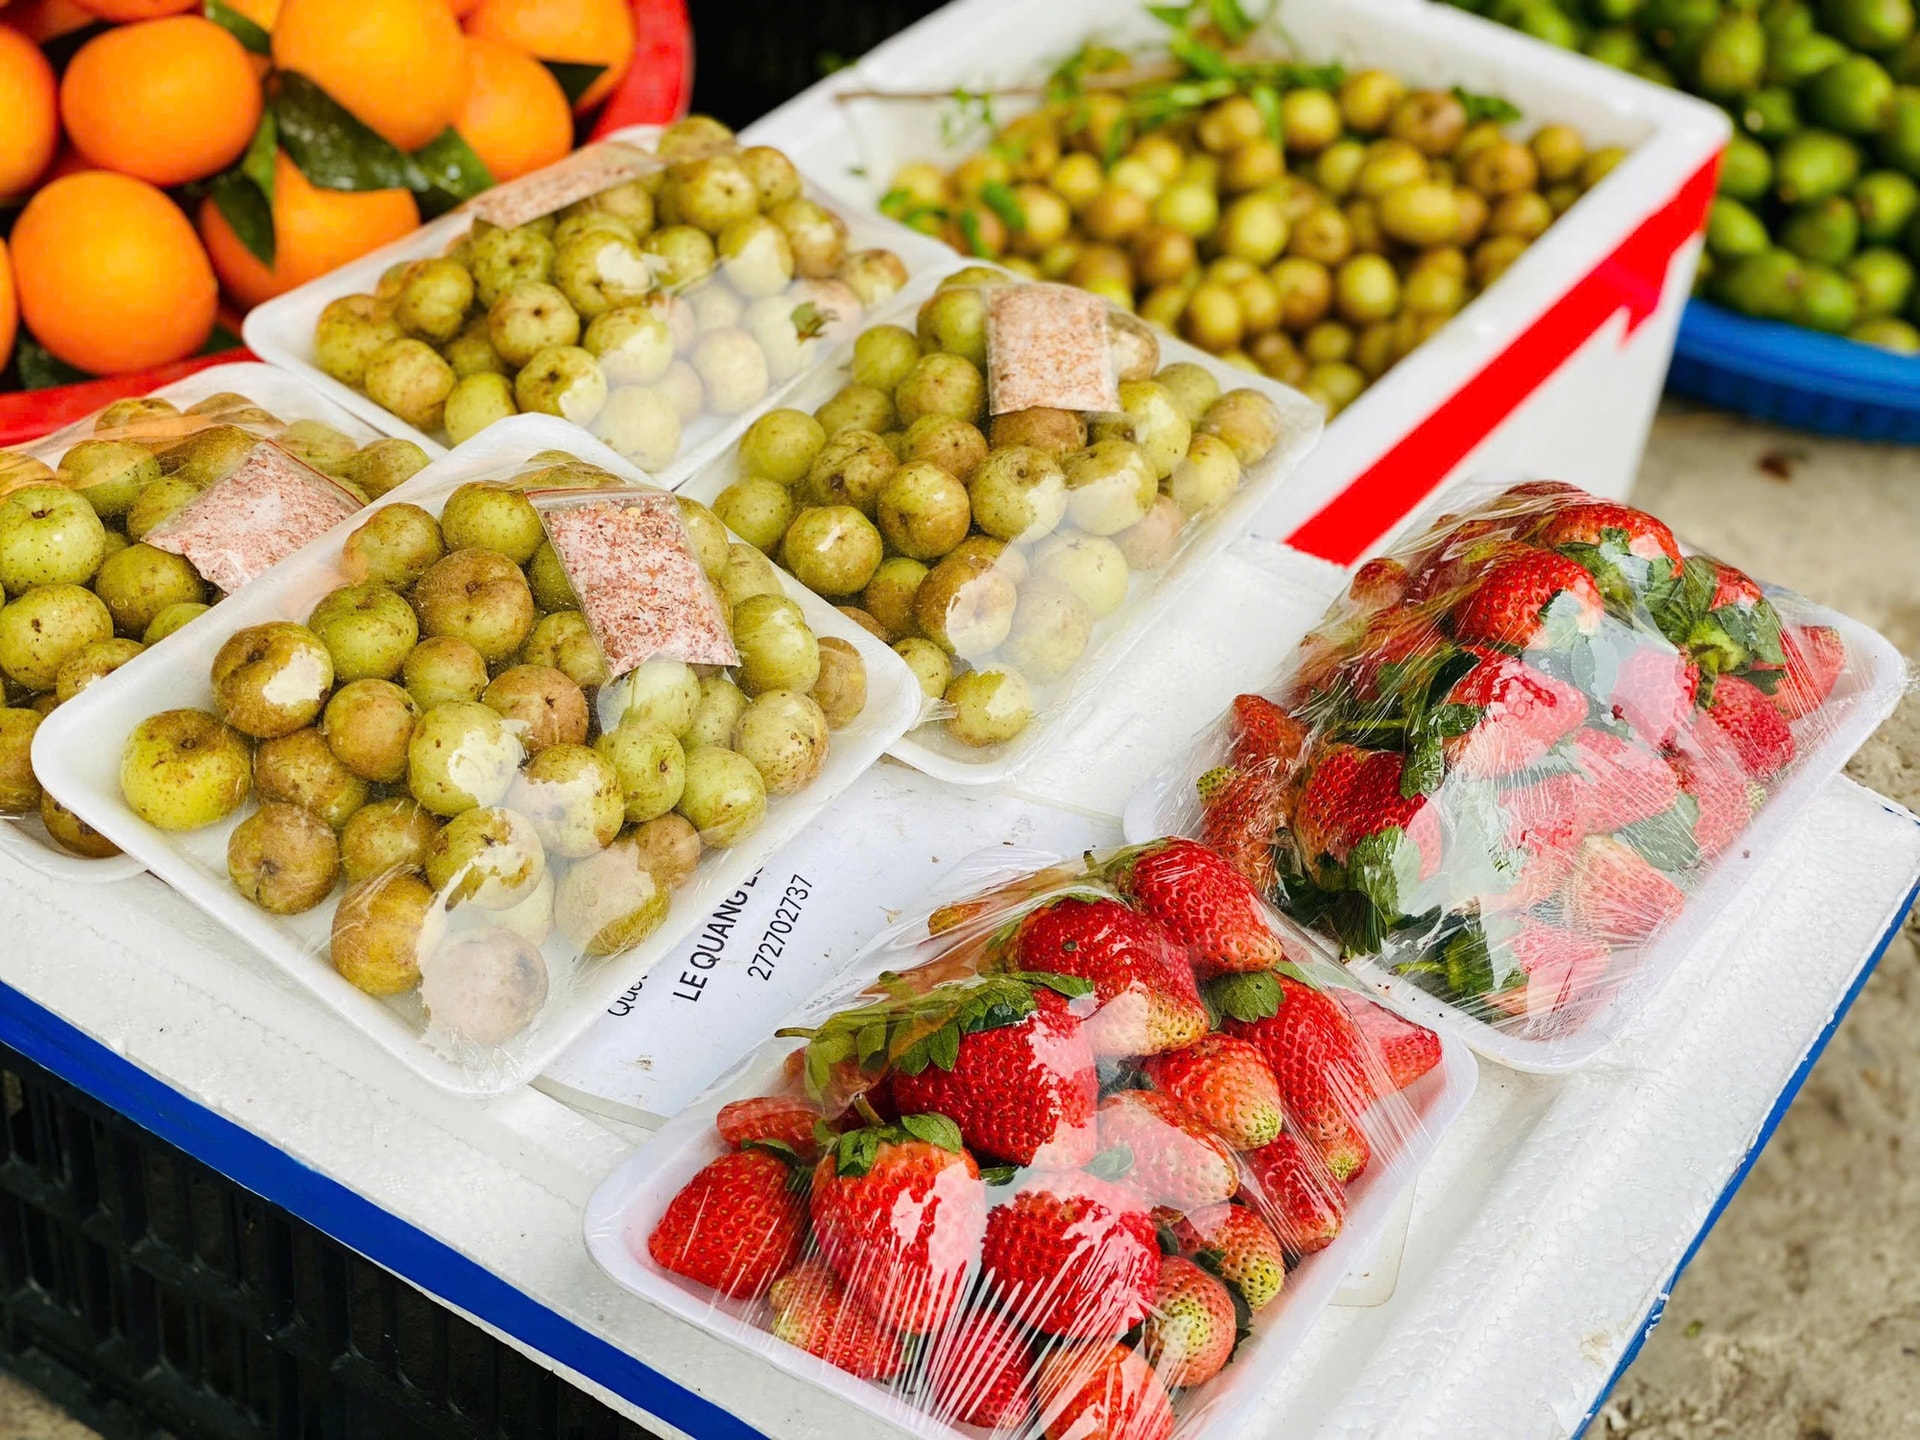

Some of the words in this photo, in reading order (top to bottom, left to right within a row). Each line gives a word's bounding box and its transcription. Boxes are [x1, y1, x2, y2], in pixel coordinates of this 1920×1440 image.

[689, 889, 749, 970] QUANG
[746, 873, 813, 981] 272702737
[672, 971, 709, 1003] LE
